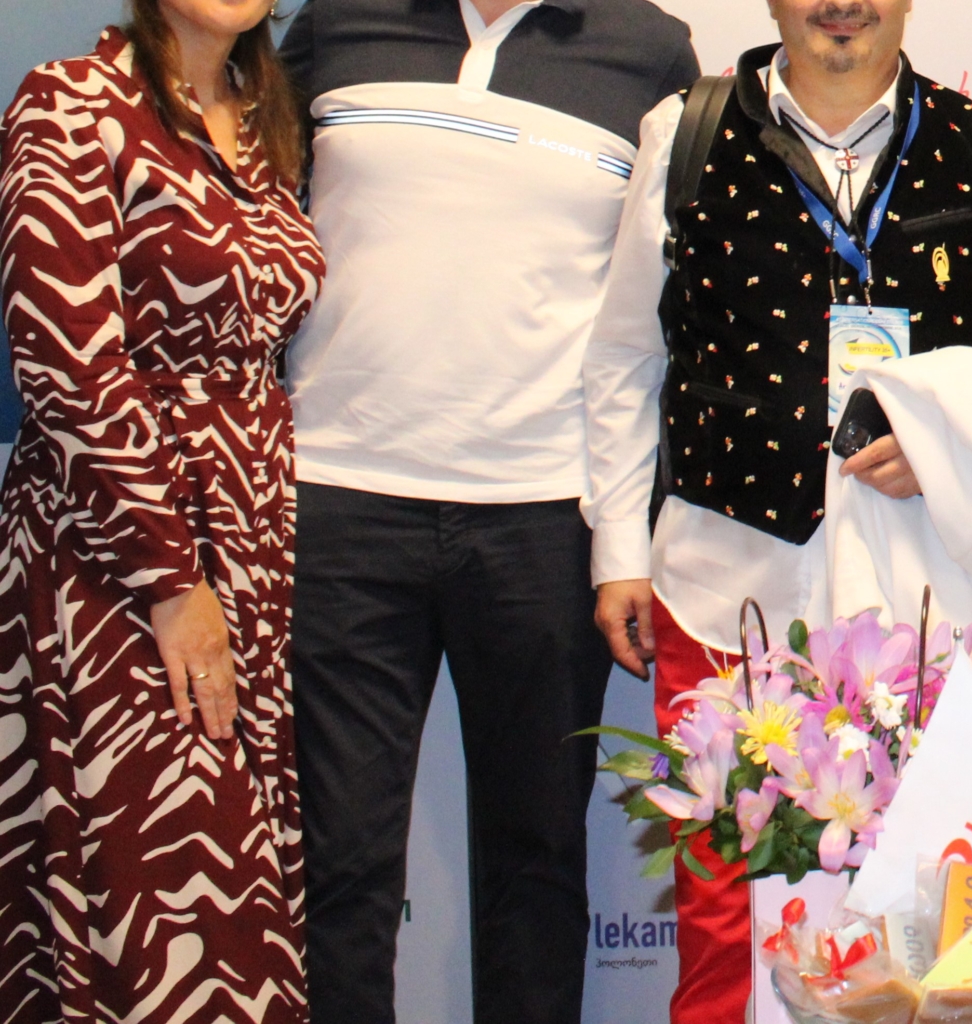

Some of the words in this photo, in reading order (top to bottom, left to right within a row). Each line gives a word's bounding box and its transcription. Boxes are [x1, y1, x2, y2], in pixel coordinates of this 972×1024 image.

[529, 134, 592, 162] LACOSTE
[870, 207, 882, 229] GGRC
[596, 957, 658, 969] პოლონეთი
